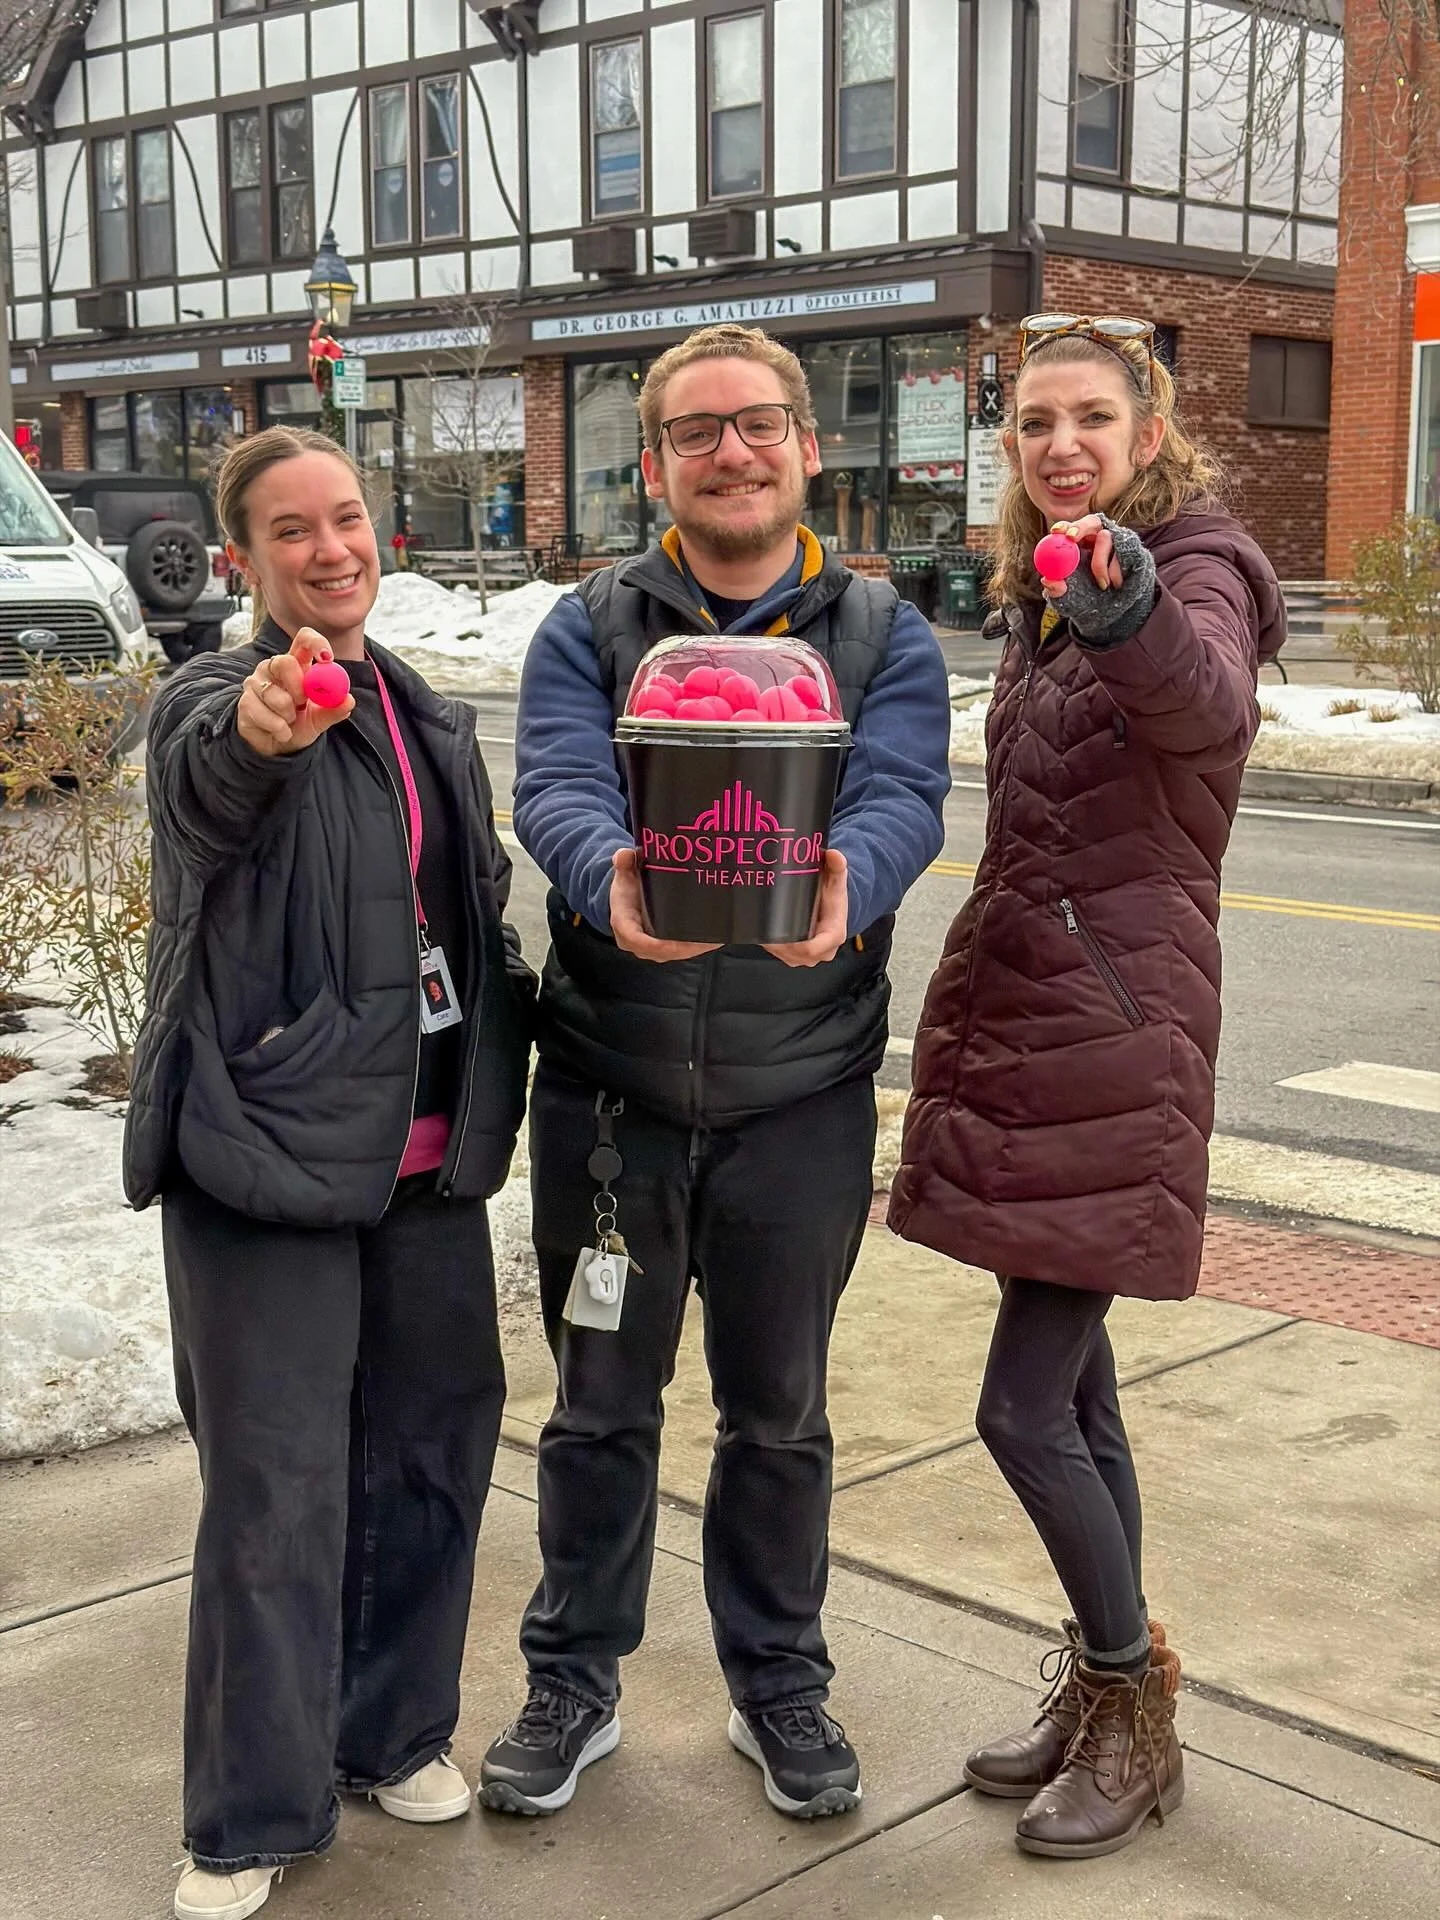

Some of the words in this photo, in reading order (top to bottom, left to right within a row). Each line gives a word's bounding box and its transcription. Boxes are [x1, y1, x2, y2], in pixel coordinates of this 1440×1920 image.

[559, 320, 584, 335] DR.
[593, 311, 664, 332] GEORGE
[674, 308, 688, 324] G.
[698, 298, 795, 321] AMATUZZI
[805, 288, 902, 310] OPTOMETRIST
[246, 346, 267, 363] 415
[917, 399, 946, 412] FLEX
[984, 391, 998, 410] X
[899, 412, 962, 428] SPENDING
[642, 827, 823, 865] PROSPECTOR
[695, 869, 775, 886] THEATER
